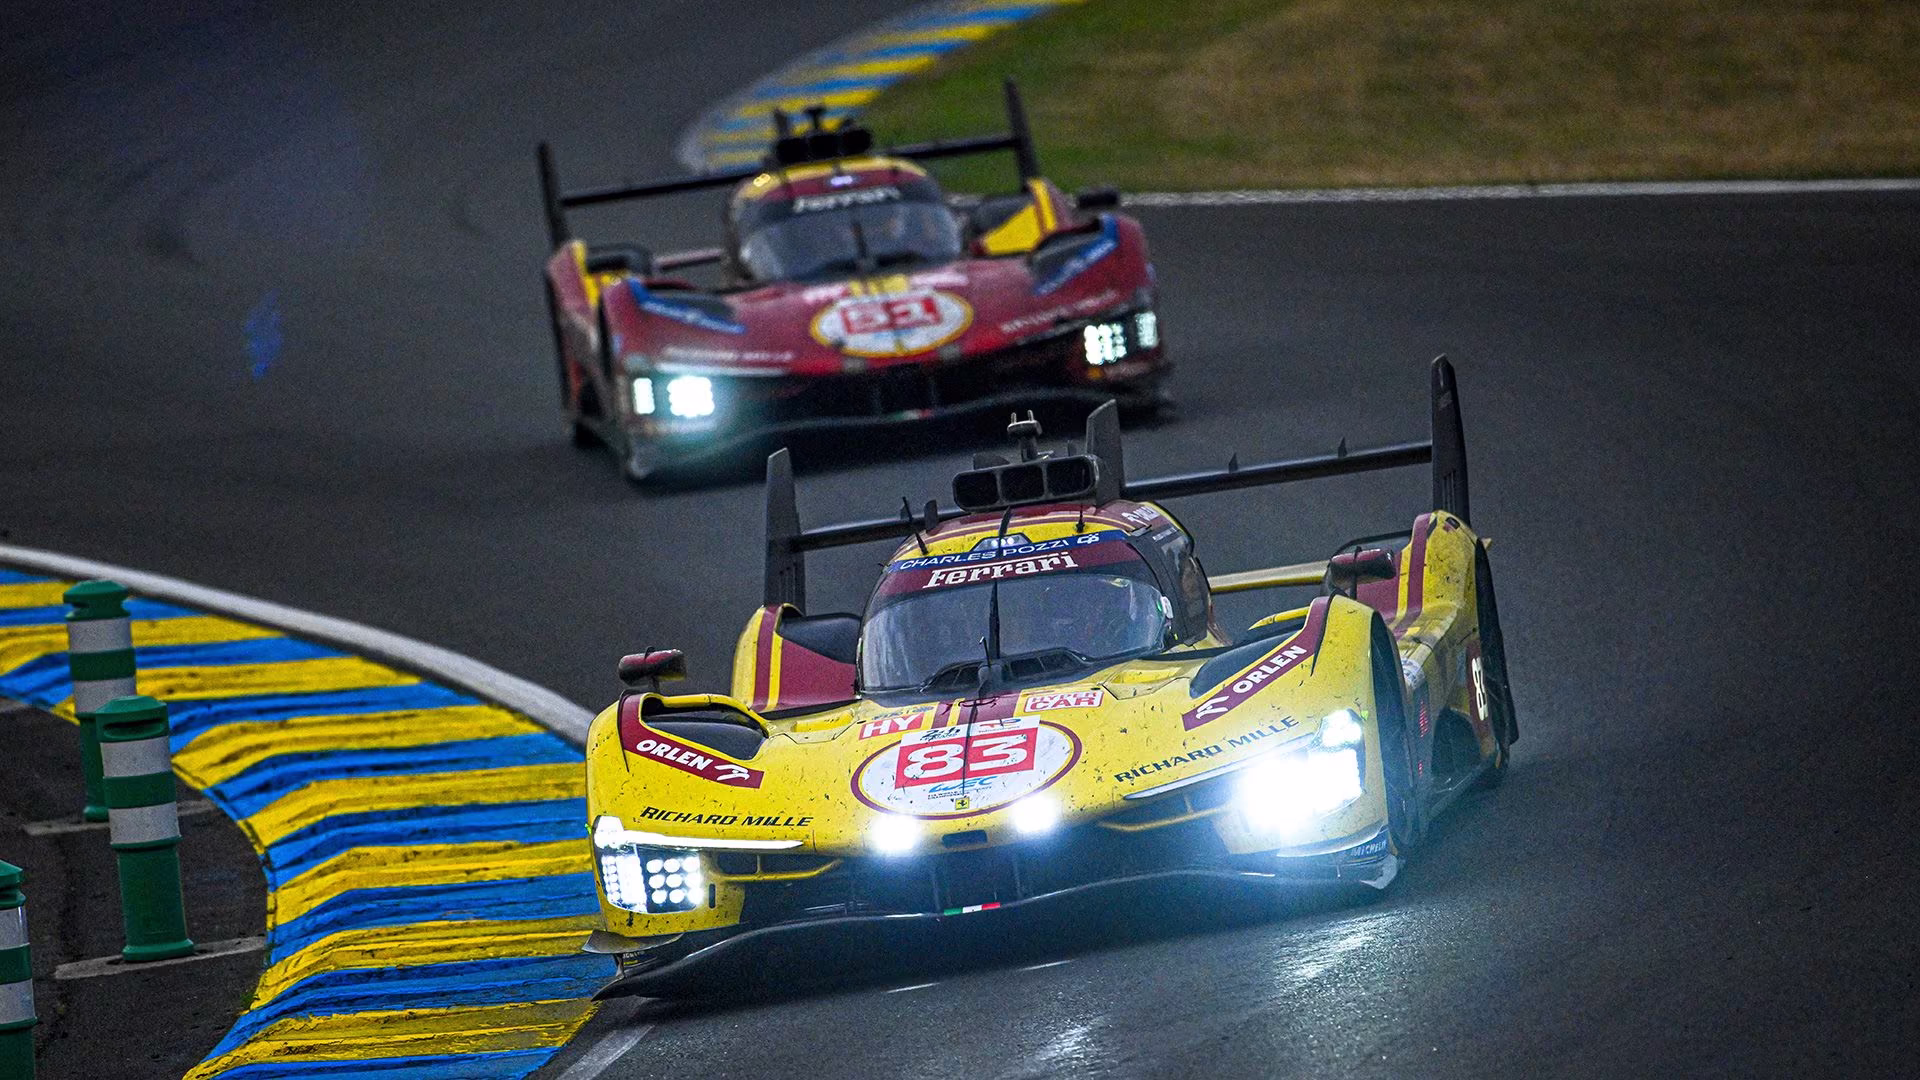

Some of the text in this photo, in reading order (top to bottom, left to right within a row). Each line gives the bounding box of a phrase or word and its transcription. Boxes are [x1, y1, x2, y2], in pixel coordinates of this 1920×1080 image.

[899, 551, 997, 570] CHARLES
[1003, 539, 1070, 557] POZZI
[922, 551, 1079, 589] Ferrari
[1232, 645, 1307, 693] ORLEN
[1030, 697, 1096, 710] CAR
[862, 713, 921, 738] HY
[636, 739, 713, 771] ORLEN
[903, 734, 1028, 779] 83
[1113, 715, 1300, 783] RICHARD MILLE
[640, 806, 814, 827] RICHARD MILLE
